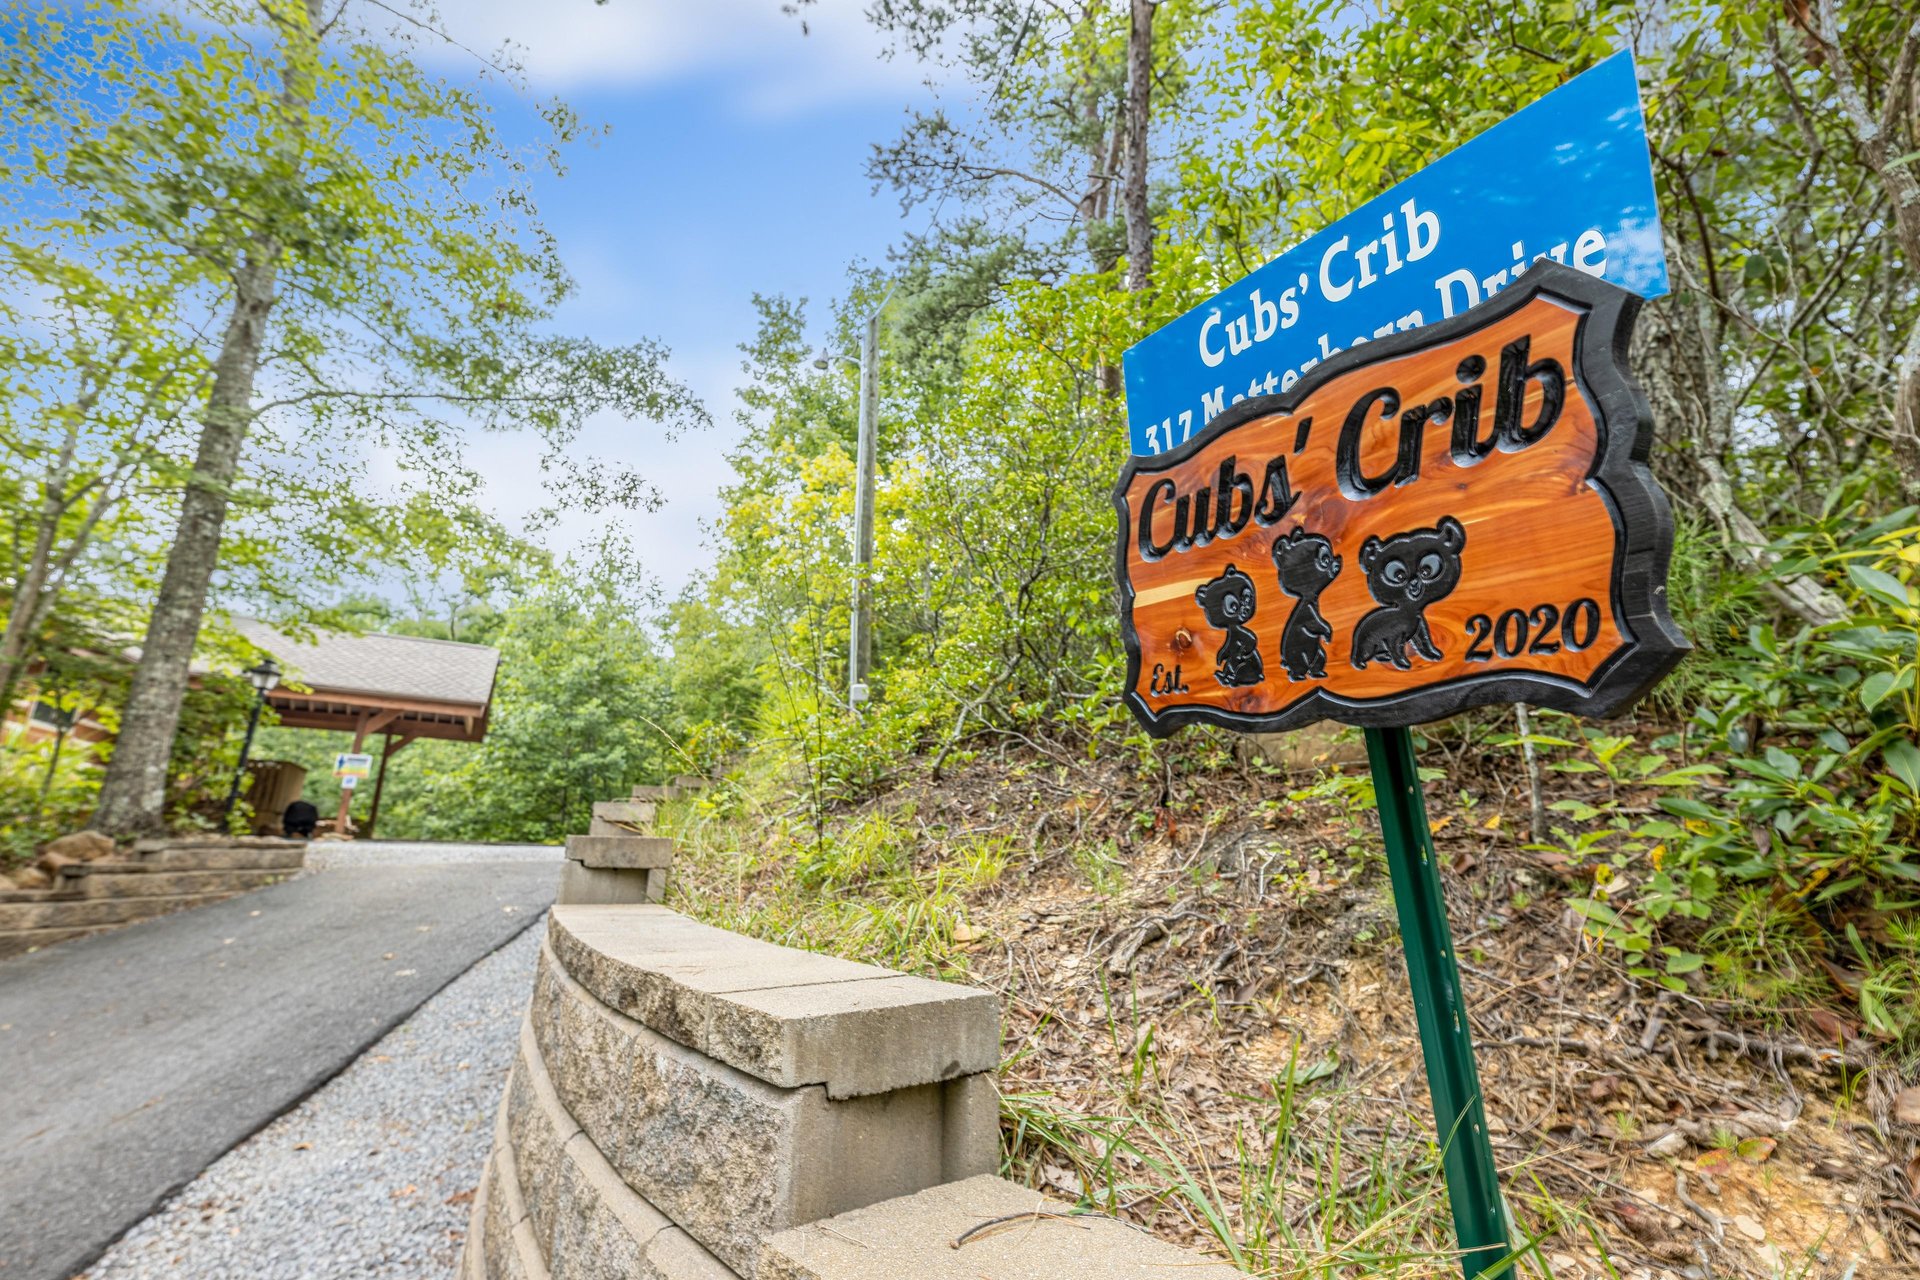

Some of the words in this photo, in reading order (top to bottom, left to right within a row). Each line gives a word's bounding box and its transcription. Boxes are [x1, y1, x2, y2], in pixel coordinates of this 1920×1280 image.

[1199, 276, 1309, 368] Cubs'
[1318, 198, 1441, 303] Crib
[1139, 417, 1314, 563] Cubs'
[1335, 334, 1567, 502] Crib
[1145, 409, 1192, 455] 317
[1201, 309, 1425, 425] Mttehn
[1150, 663, 1190, 697] Est.
[1464, 597, 1601, 663] 2020
